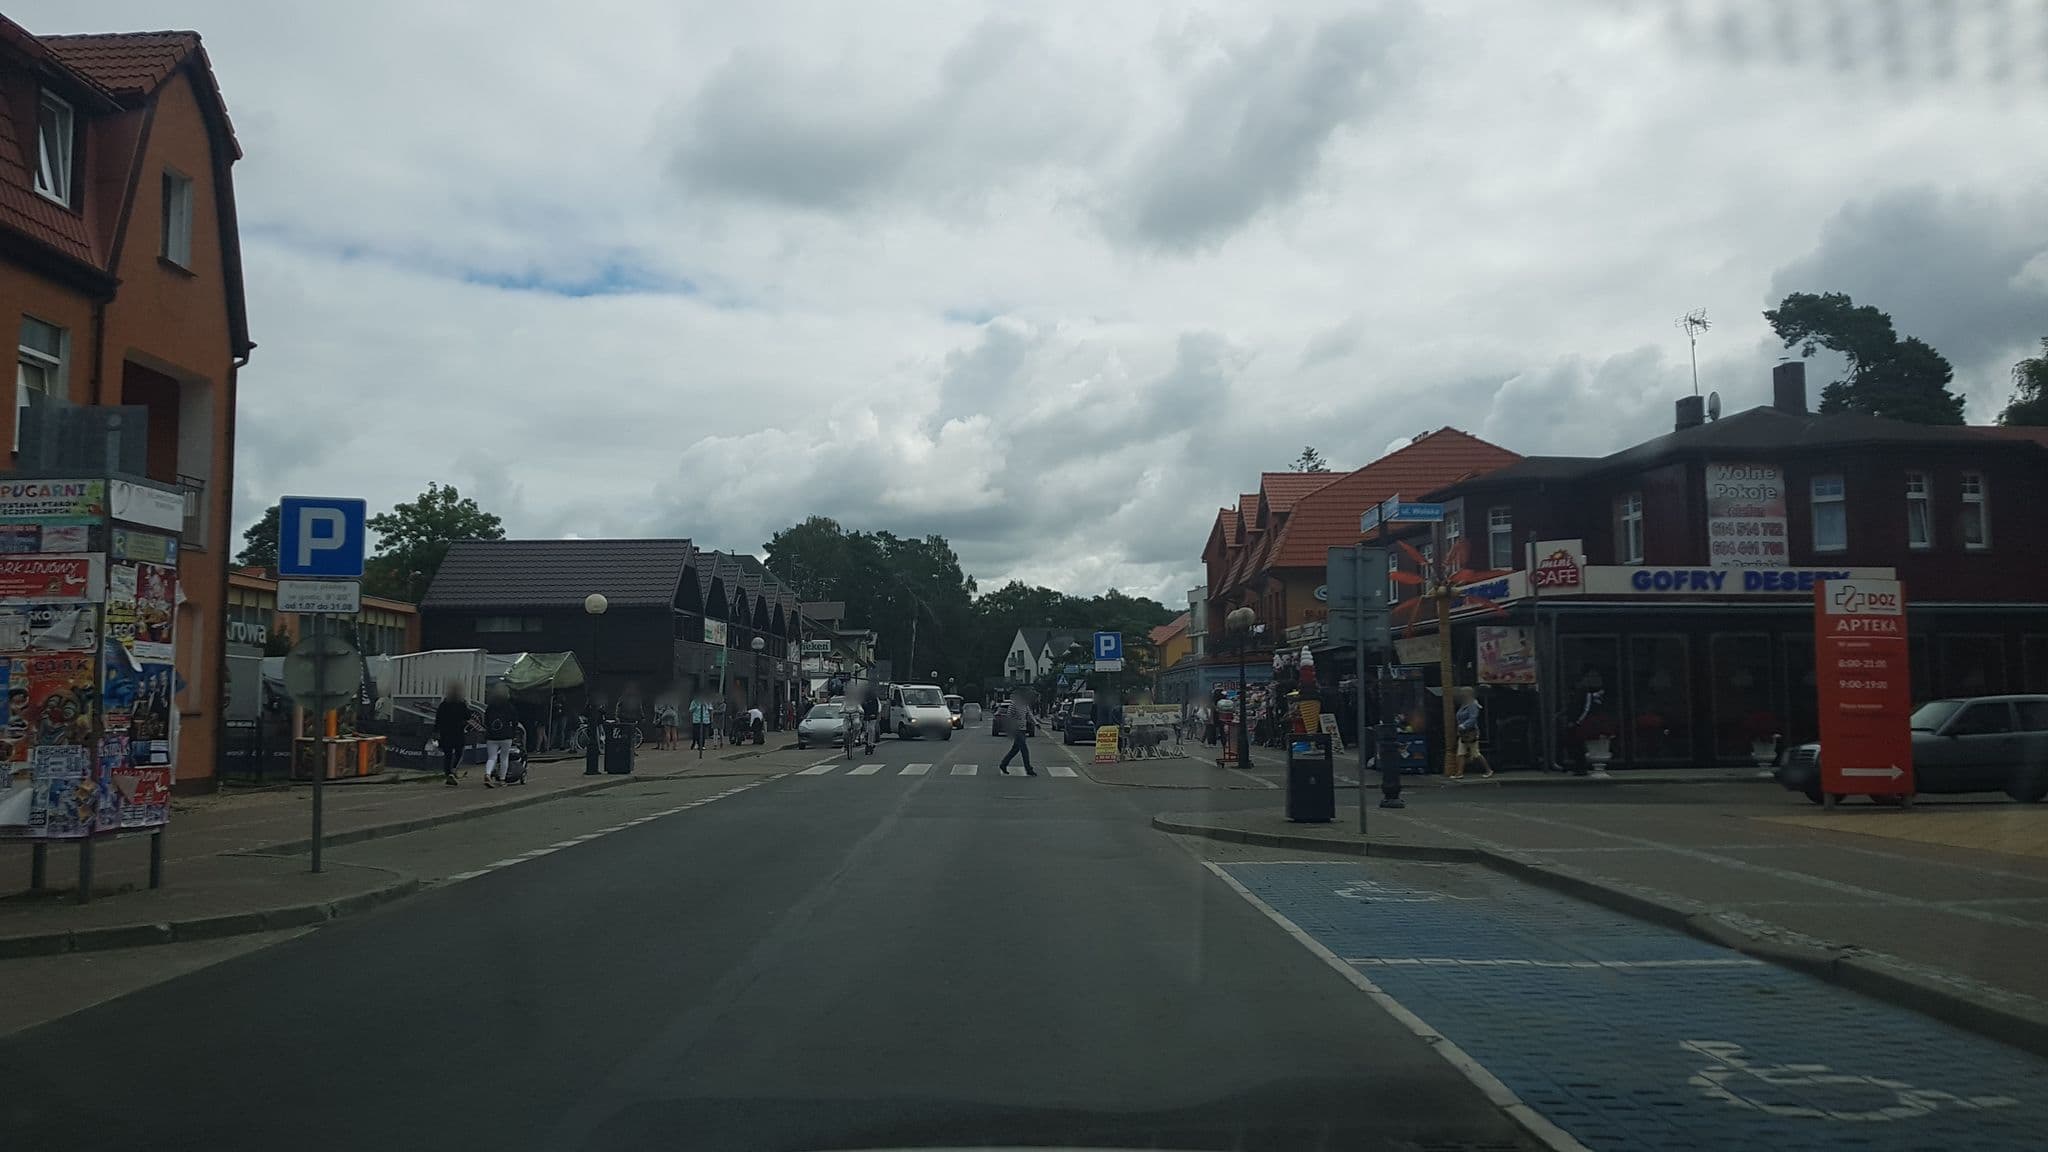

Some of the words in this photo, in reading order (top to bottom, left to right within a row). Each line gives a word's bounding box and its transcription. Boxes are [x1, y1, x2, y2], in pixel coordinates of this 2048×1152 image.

[1719, 466, 1777, 480] Wolne
[1714, 483, 1777, 502] Pokoje
[298, 507, 346, 567] P
[1632, 571, 1727, 591] GOFRY
[1868, 593, 1896, 606] DOZ
[1837, 620, 1897, 632] APTEKA
[1100, 636, 1115, 657] P
